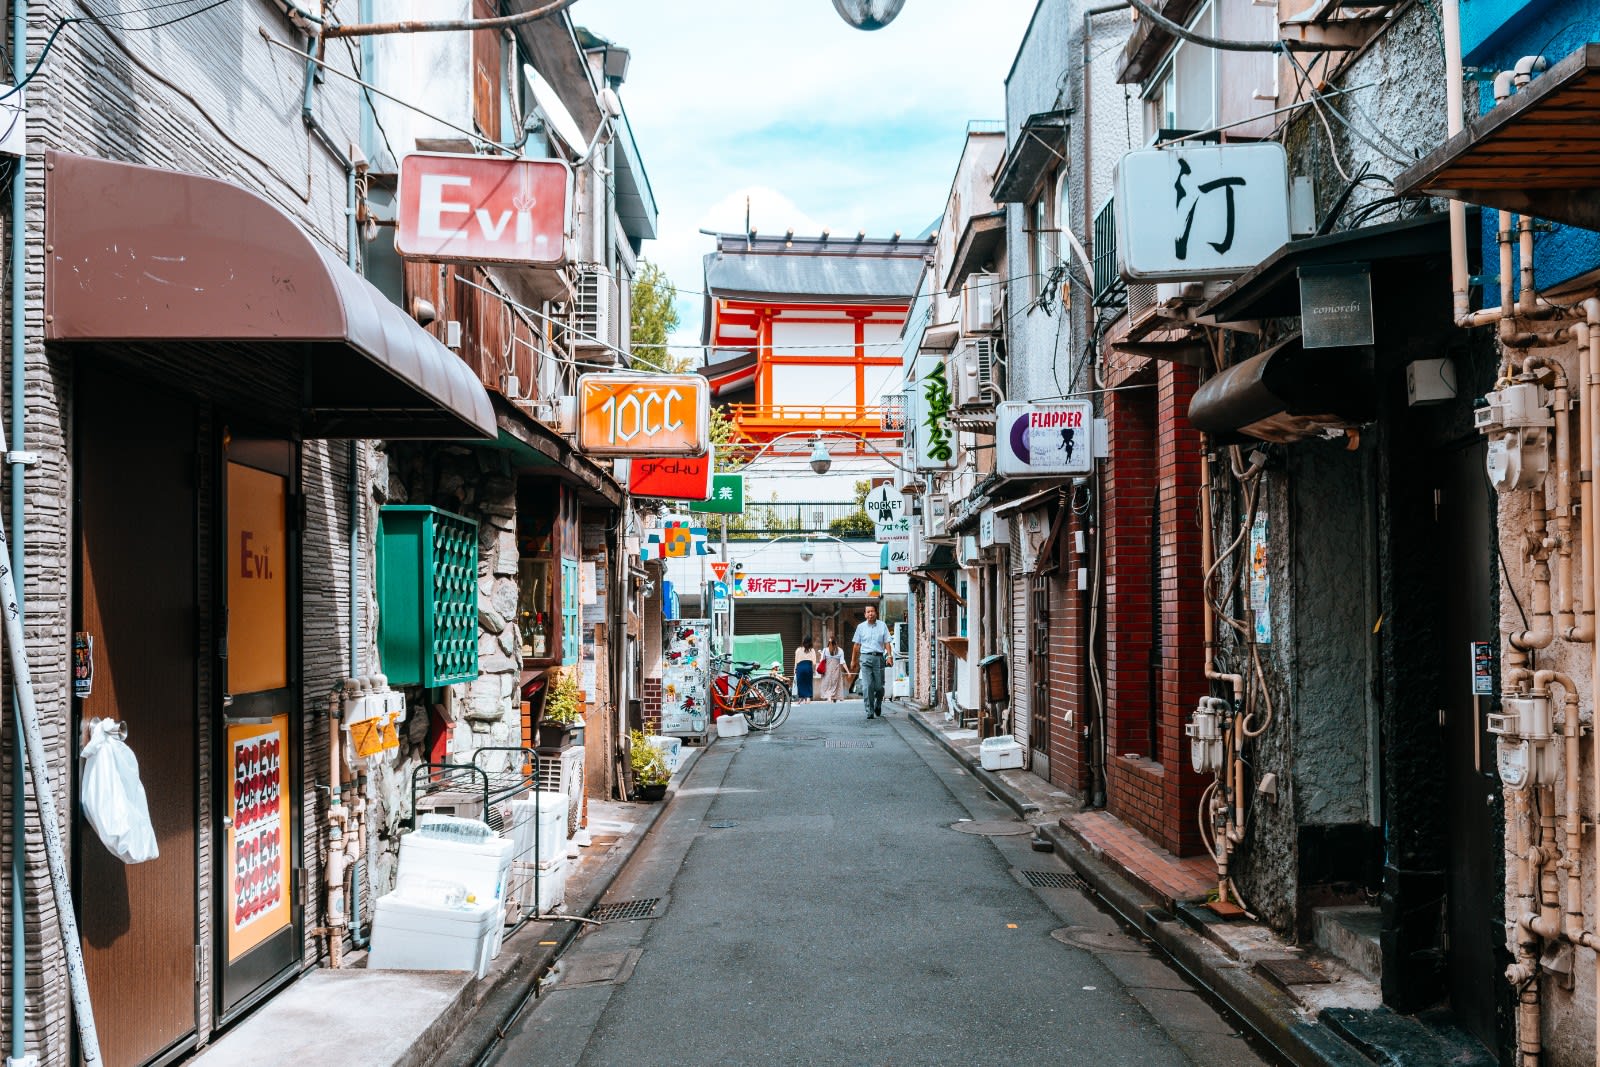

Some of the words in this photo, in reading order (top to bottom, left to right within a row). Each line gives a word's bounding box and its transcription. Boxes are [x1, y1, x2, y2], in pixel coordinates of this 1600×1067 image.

[418, 173, 549, 244] Evi.
[1174, 158, 1247, 260] 汀
[1313, 301, 1361, 314] comorebi
[1031, 410, 1083, 429] FLAPPER
[868, 500, 903, 510] ROCKET
[241, 530, 273, 580] Evi.
[747, 577, 867, 593] 新宿ゴールデン街
